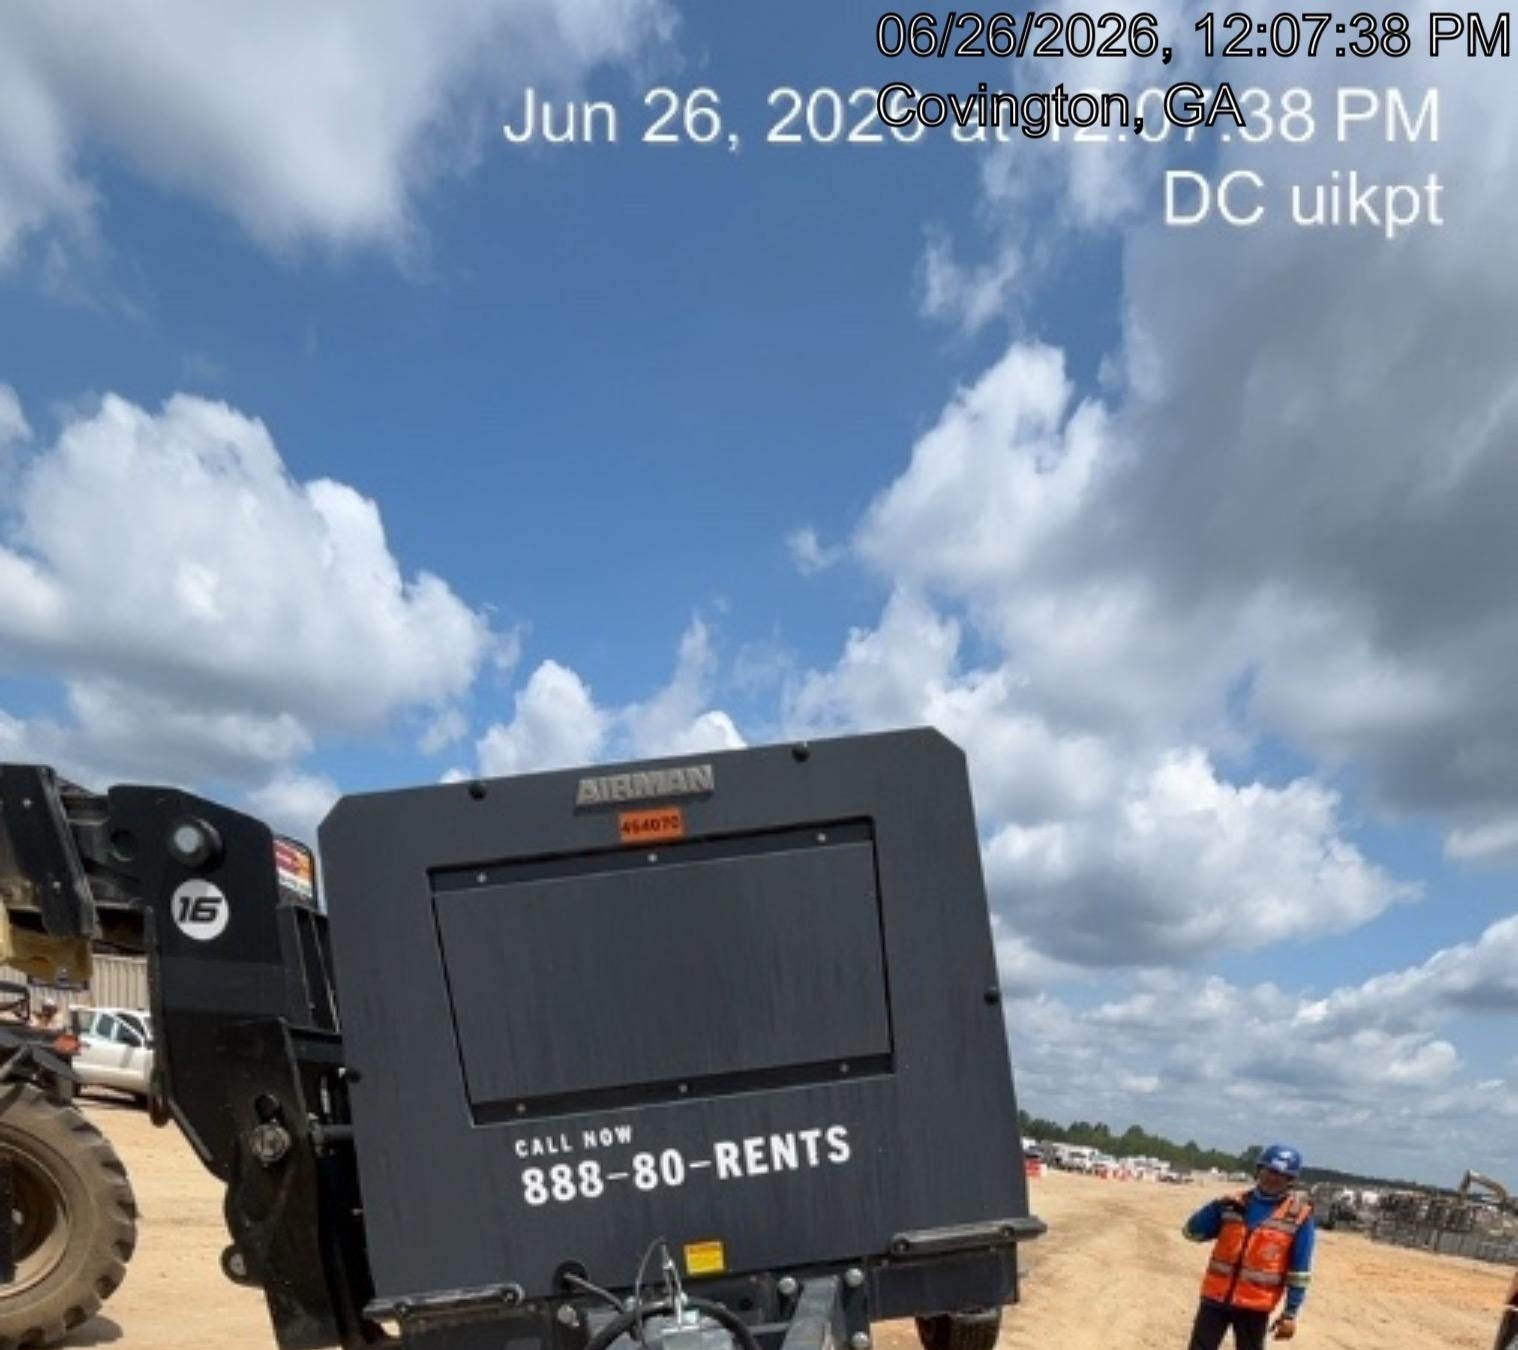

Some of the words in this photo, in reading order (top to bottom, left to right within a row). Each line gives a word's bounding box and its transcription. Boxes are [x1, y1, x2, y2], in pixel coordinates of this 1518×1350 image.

[575, 764, 715, 806] AIRMAN
[178, 896, 223, 923] 16
[514, 1134, 573, 1158] CALL
[583, 1125, 634, 1148] NOW
[521, 1125, 852, 1206] 888-80-RENTS
